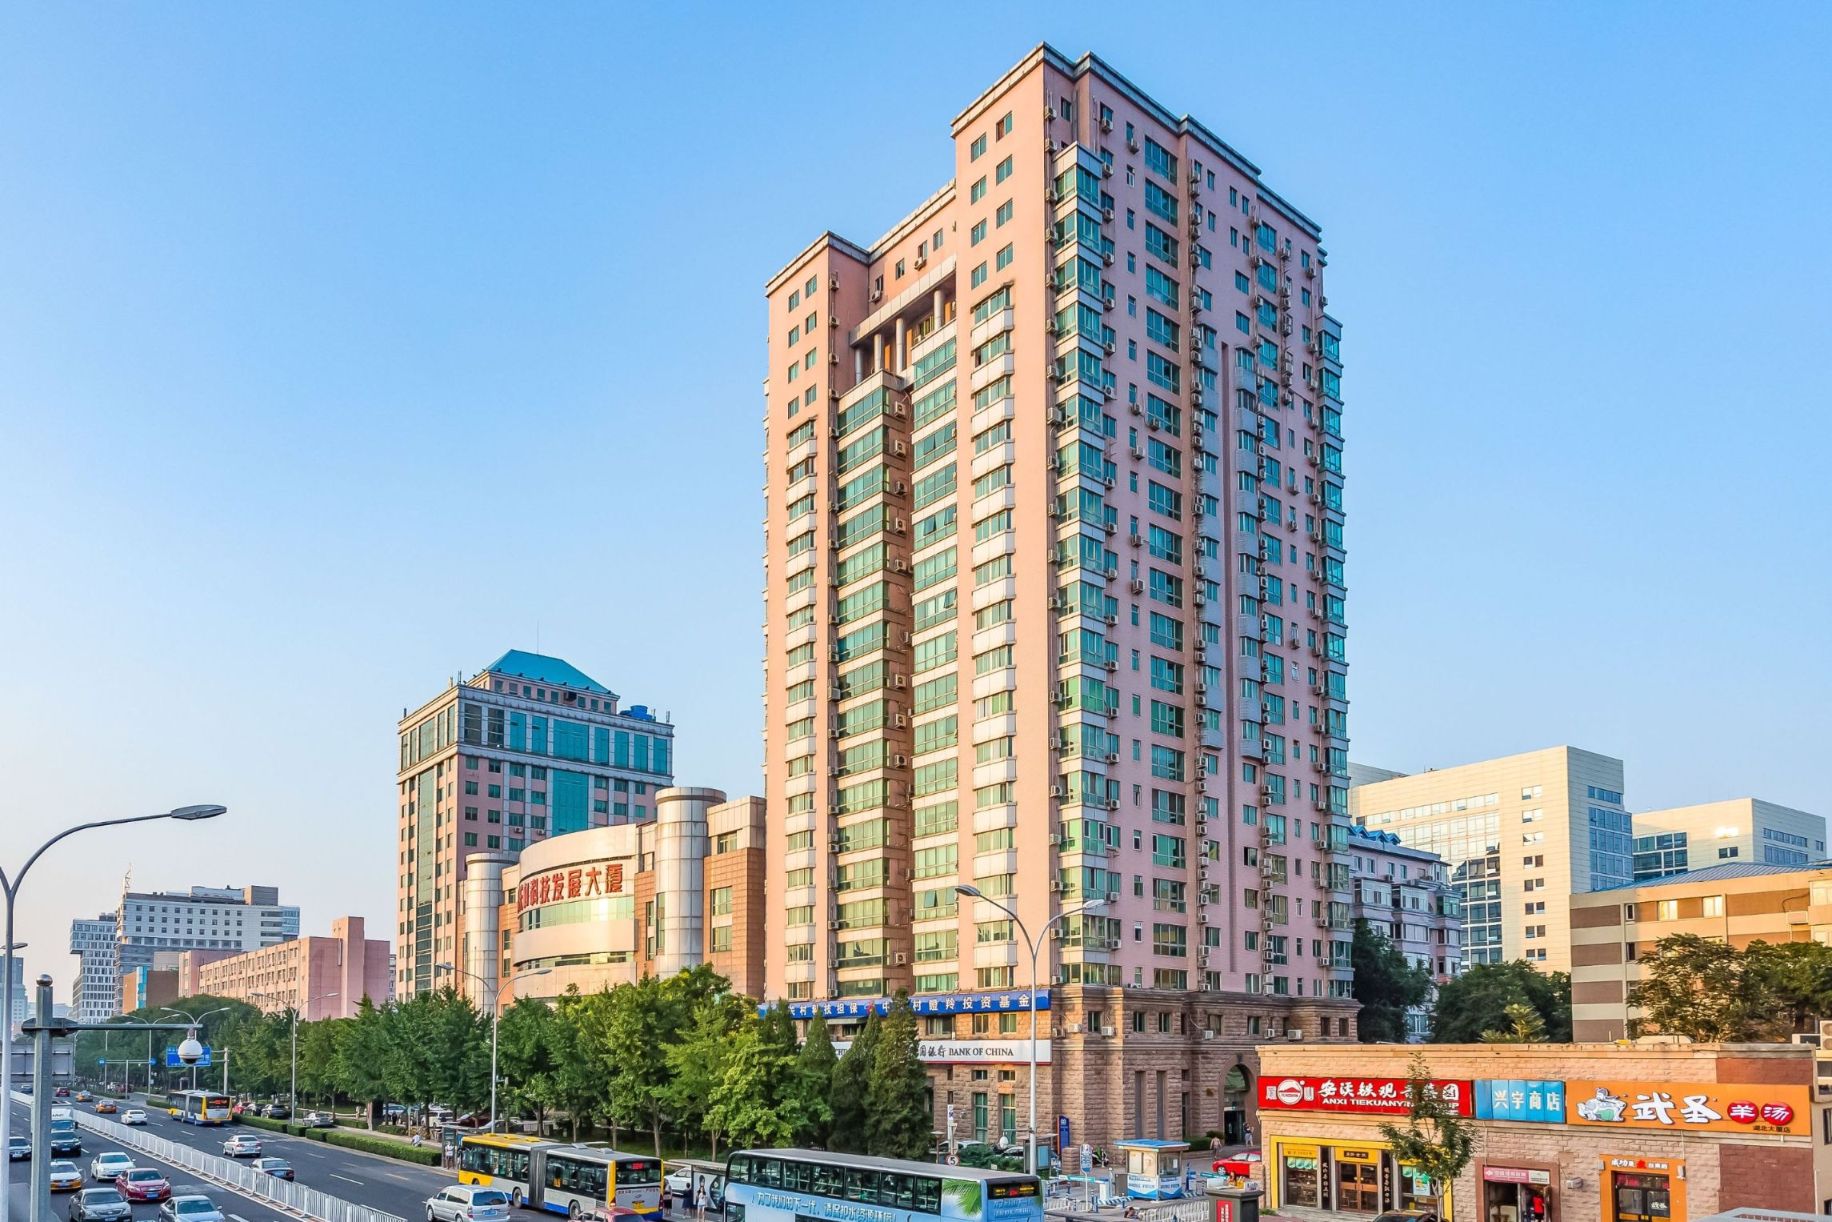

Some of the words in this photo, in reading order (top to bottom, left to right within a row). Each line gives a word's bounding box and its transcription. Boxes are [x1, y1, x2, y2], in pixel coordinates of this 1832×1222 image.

[948, 1048, 971, 1057] BANK
[972, 1047, 984, 1057] OF
[985, 1047, 1014, 1057] CHINA
[1322, 1097, 1347, 1106] ANXI
[1494, 1090, 1561, 1111] 兴宇商店
[950, 1156, 956, 1165] 5
